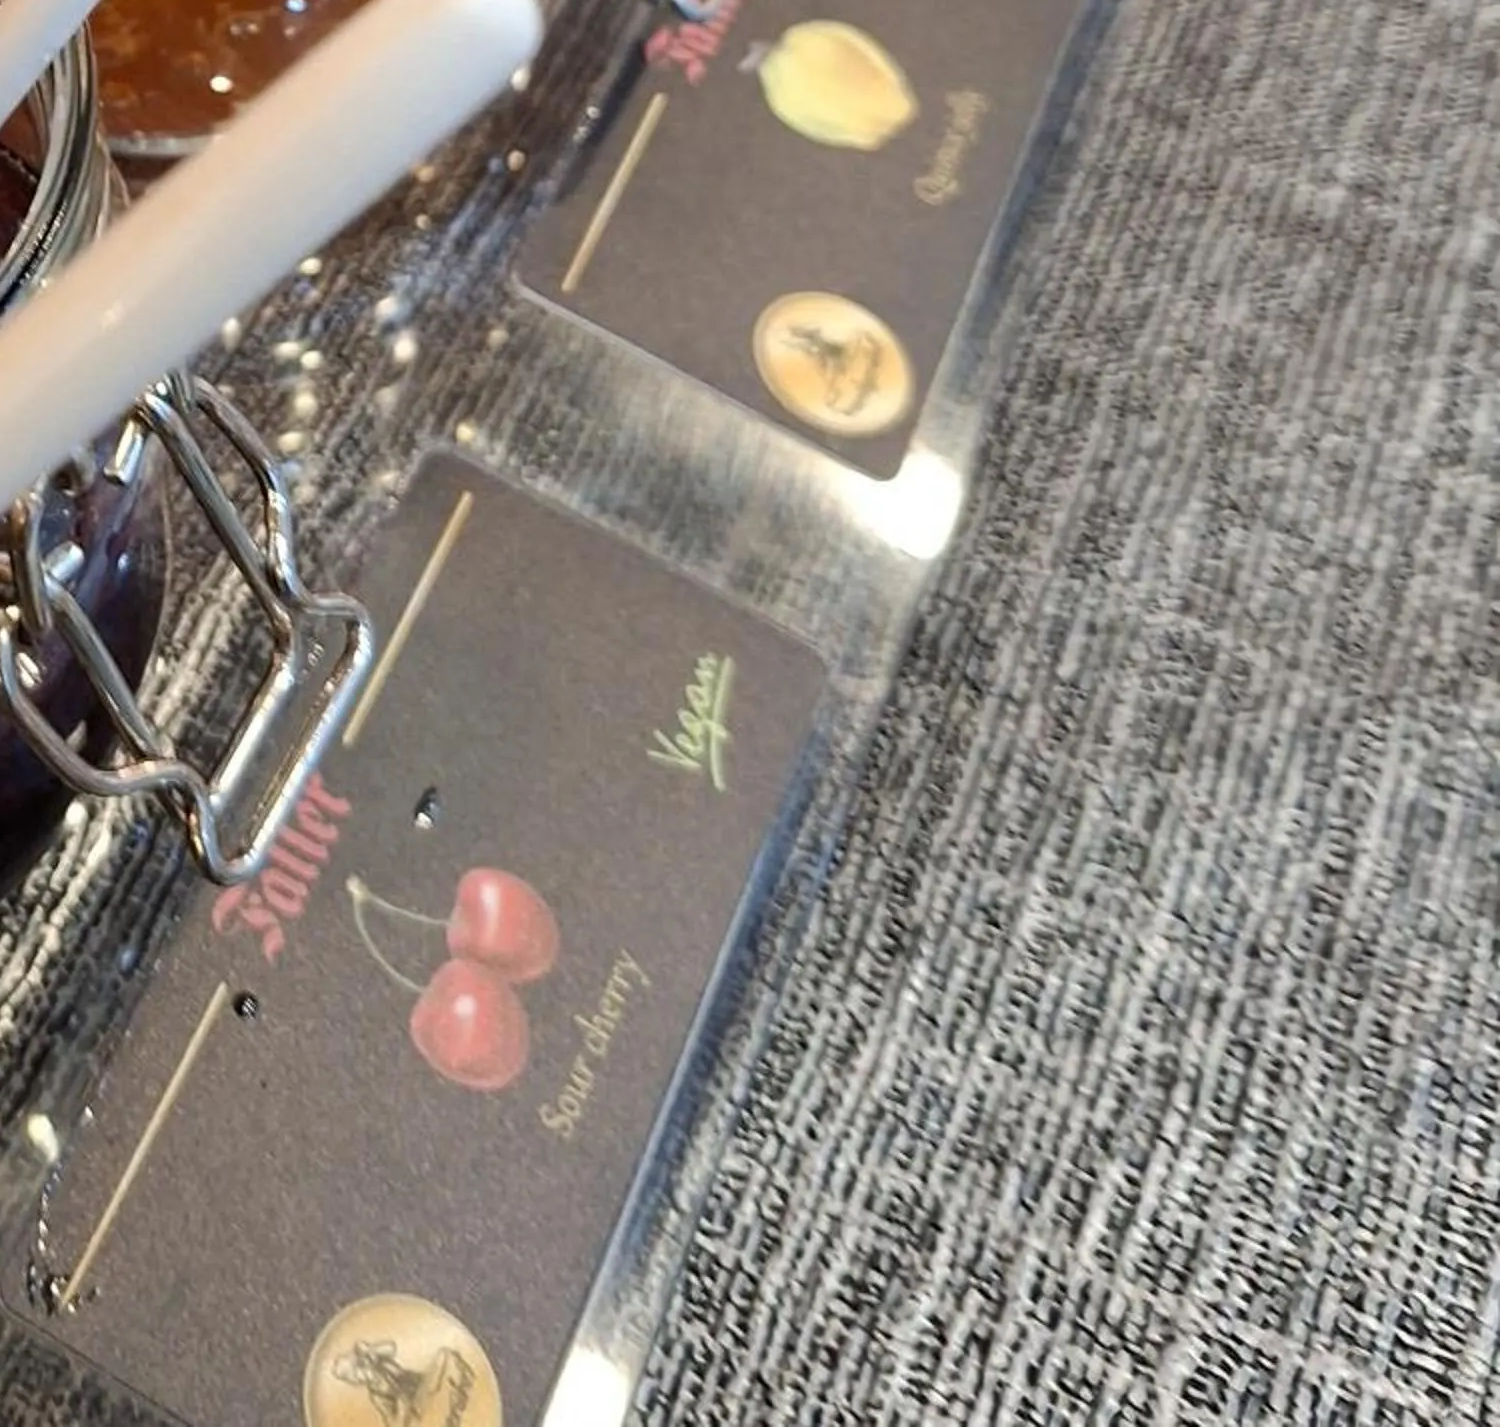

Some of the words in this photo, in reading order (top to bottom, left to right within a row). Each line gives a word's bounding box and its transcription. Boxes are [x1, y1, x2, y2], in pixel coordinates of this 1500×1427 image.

[646, 652, 734, 773] Vegan
[537, 1055, 595, 1138] Sour
[573, 948, 652, 1058] cherry
